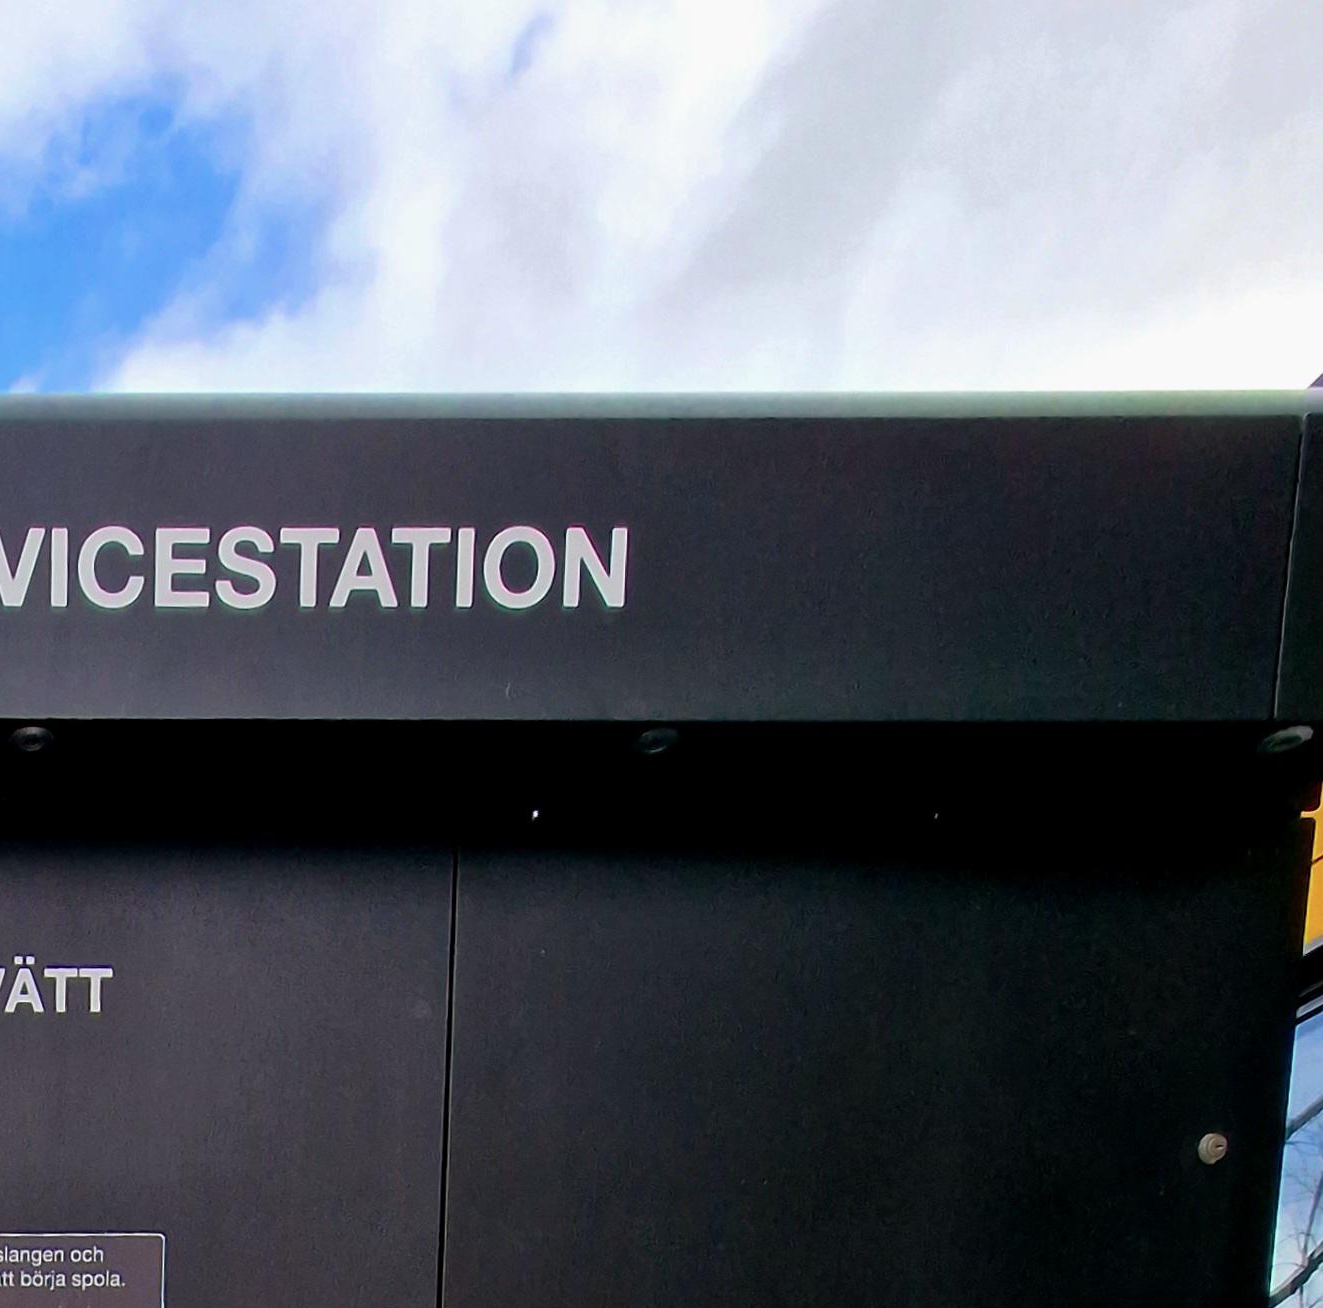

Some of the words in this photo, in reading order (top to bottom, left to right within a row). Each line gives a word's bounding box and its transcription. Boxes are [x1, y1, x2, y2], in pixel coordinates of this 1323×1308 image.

[70, 1245, 105, 1263] och
[20, 1269, 67, 1291] börja
[71, 1269, 126, 1291] spola.
